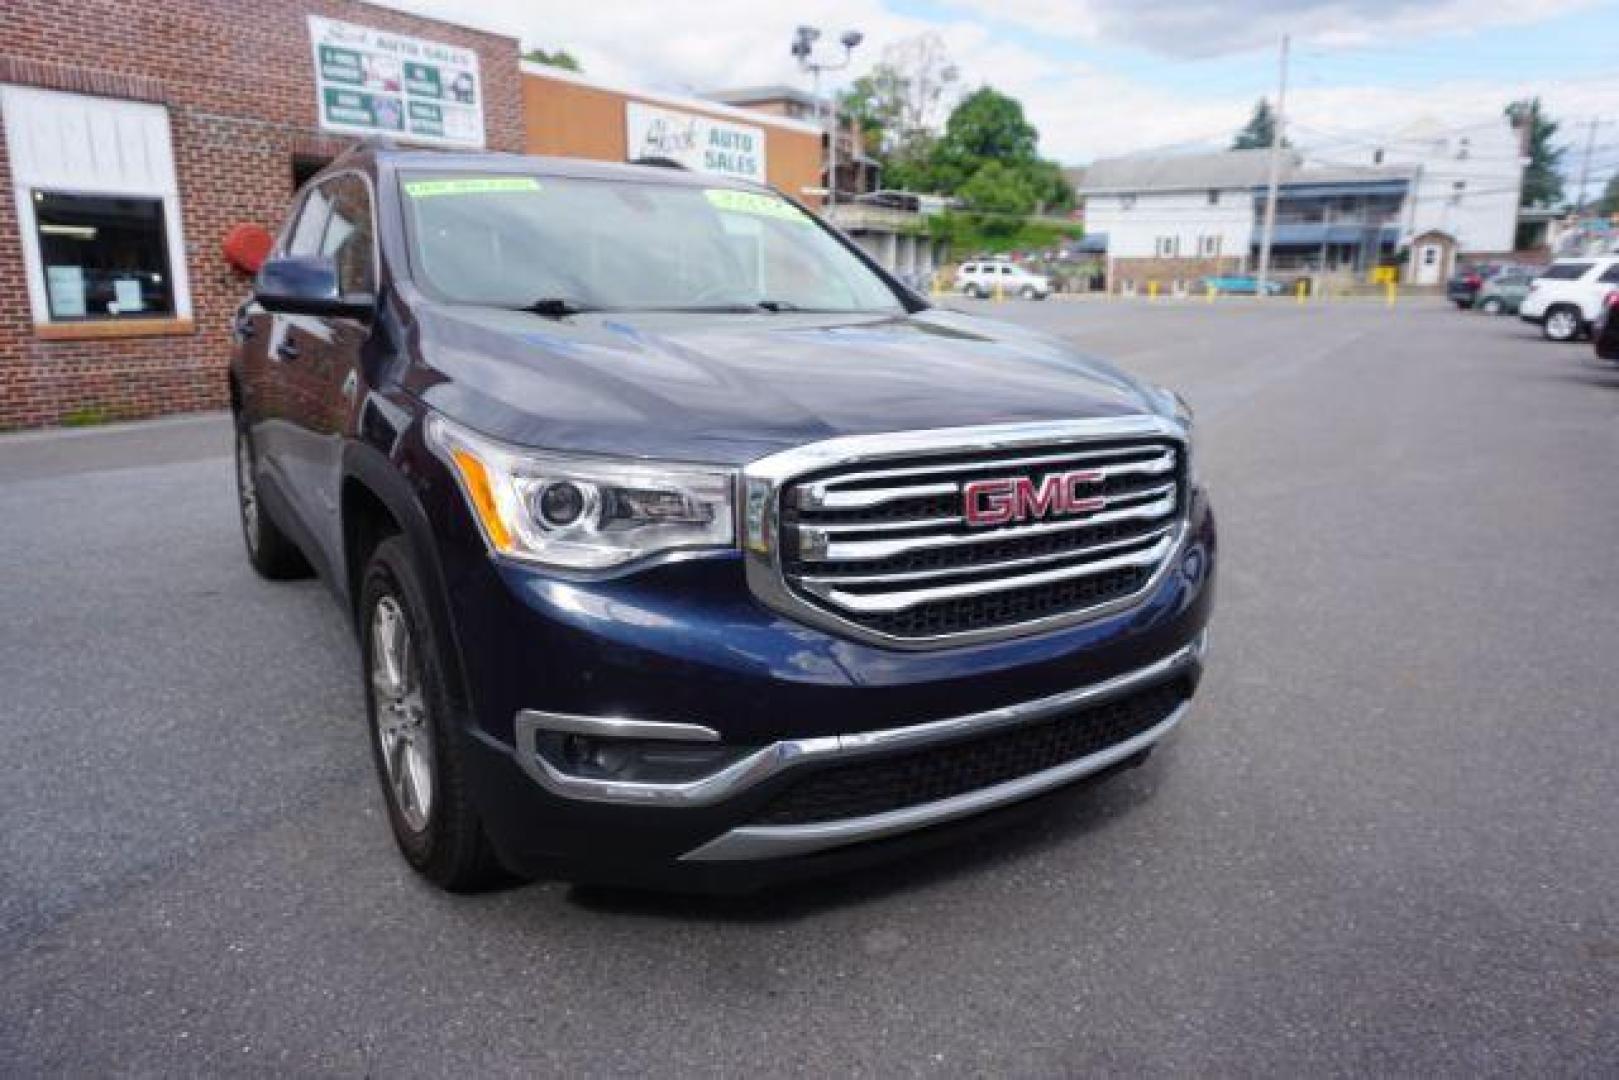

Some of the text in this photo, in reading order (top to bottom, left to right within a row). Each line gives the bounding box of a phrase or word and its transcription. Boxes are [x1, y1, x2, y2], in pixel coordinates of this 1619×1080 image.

[376, 37, 419, 55] AUTO
[709, 127, 752, 153] AUTO
[705, 151, 757, 175] SALES
[963, 468, 1106, 526] GMC
